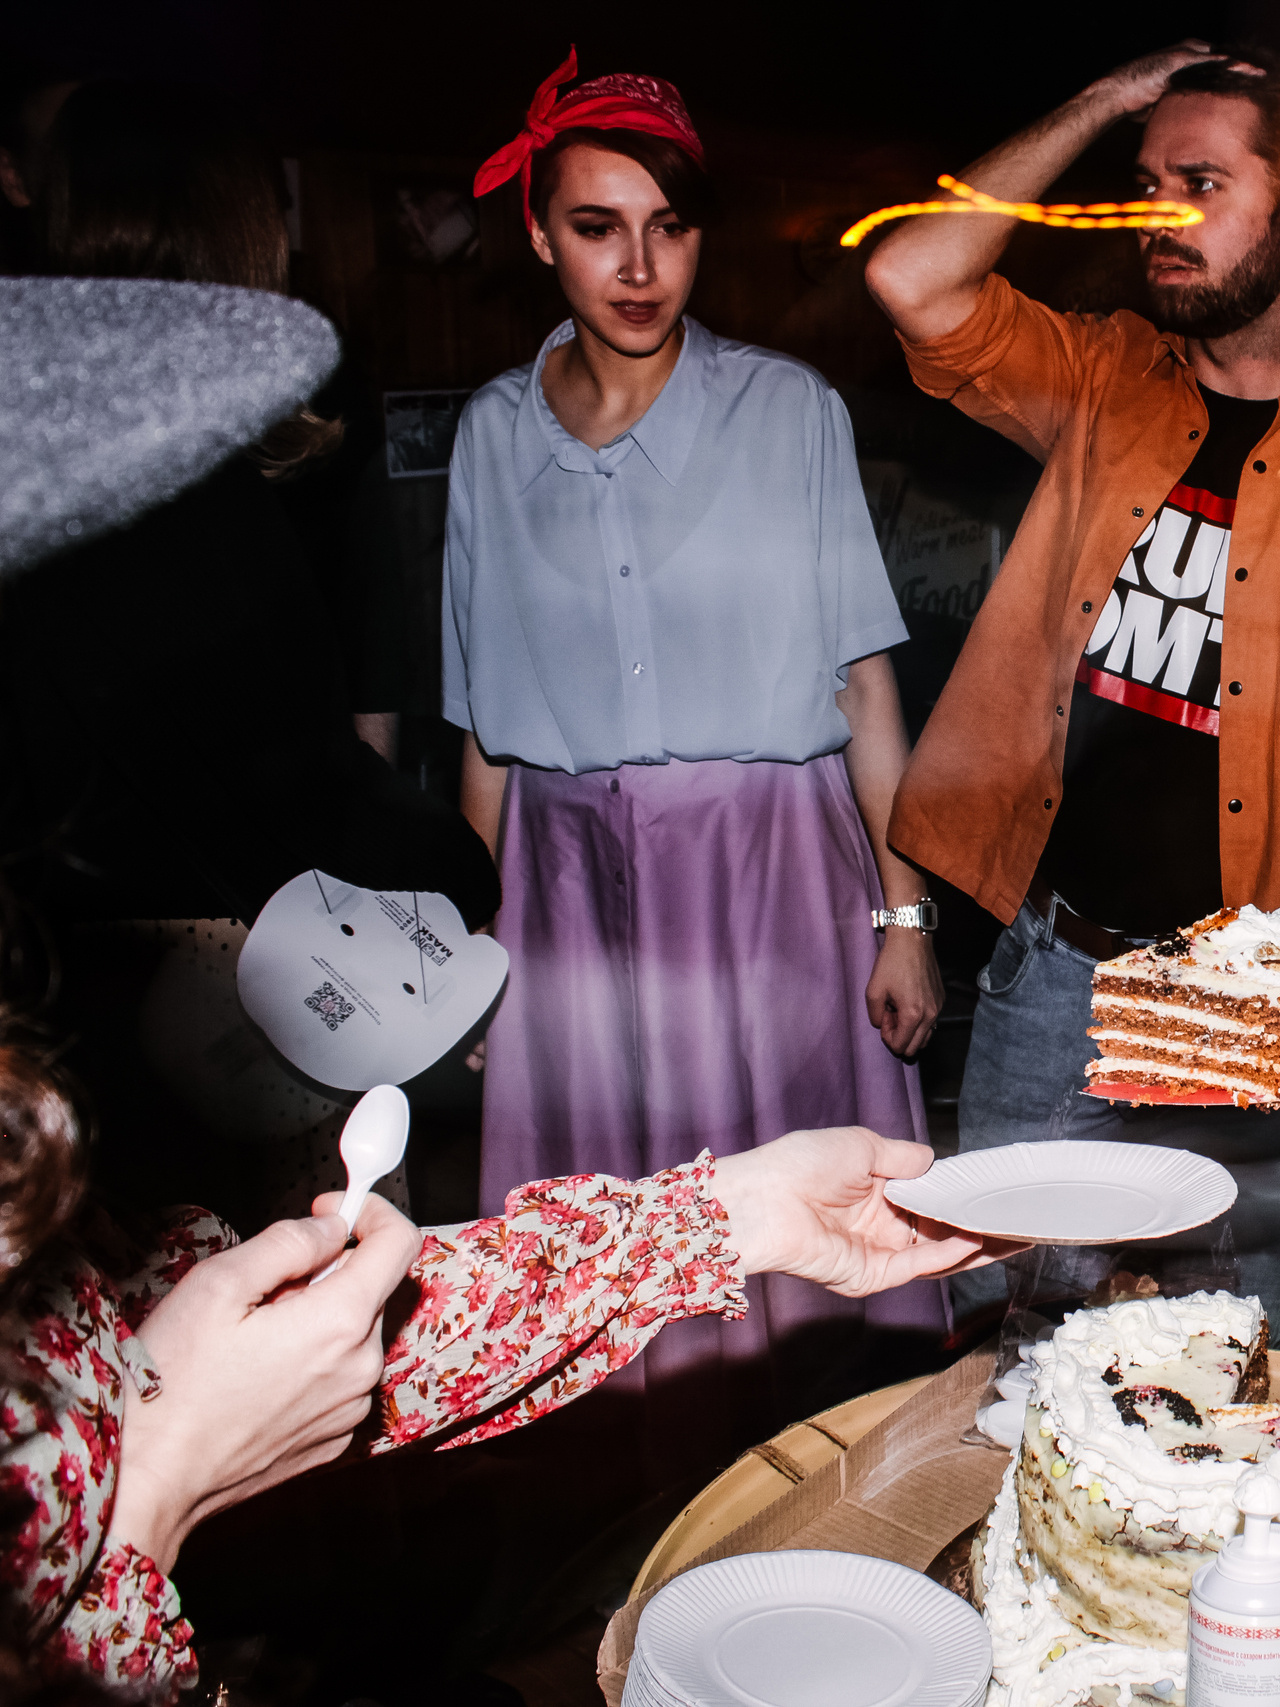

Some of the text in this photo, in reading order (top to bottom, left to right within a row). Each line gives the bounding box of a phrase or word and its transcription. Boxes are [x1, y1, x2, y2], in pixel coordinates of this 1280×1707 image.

[896, 527, 941, 566] Warm
[899, 562, 990, 618] Food
[419, 927, 453, 957] MASK
